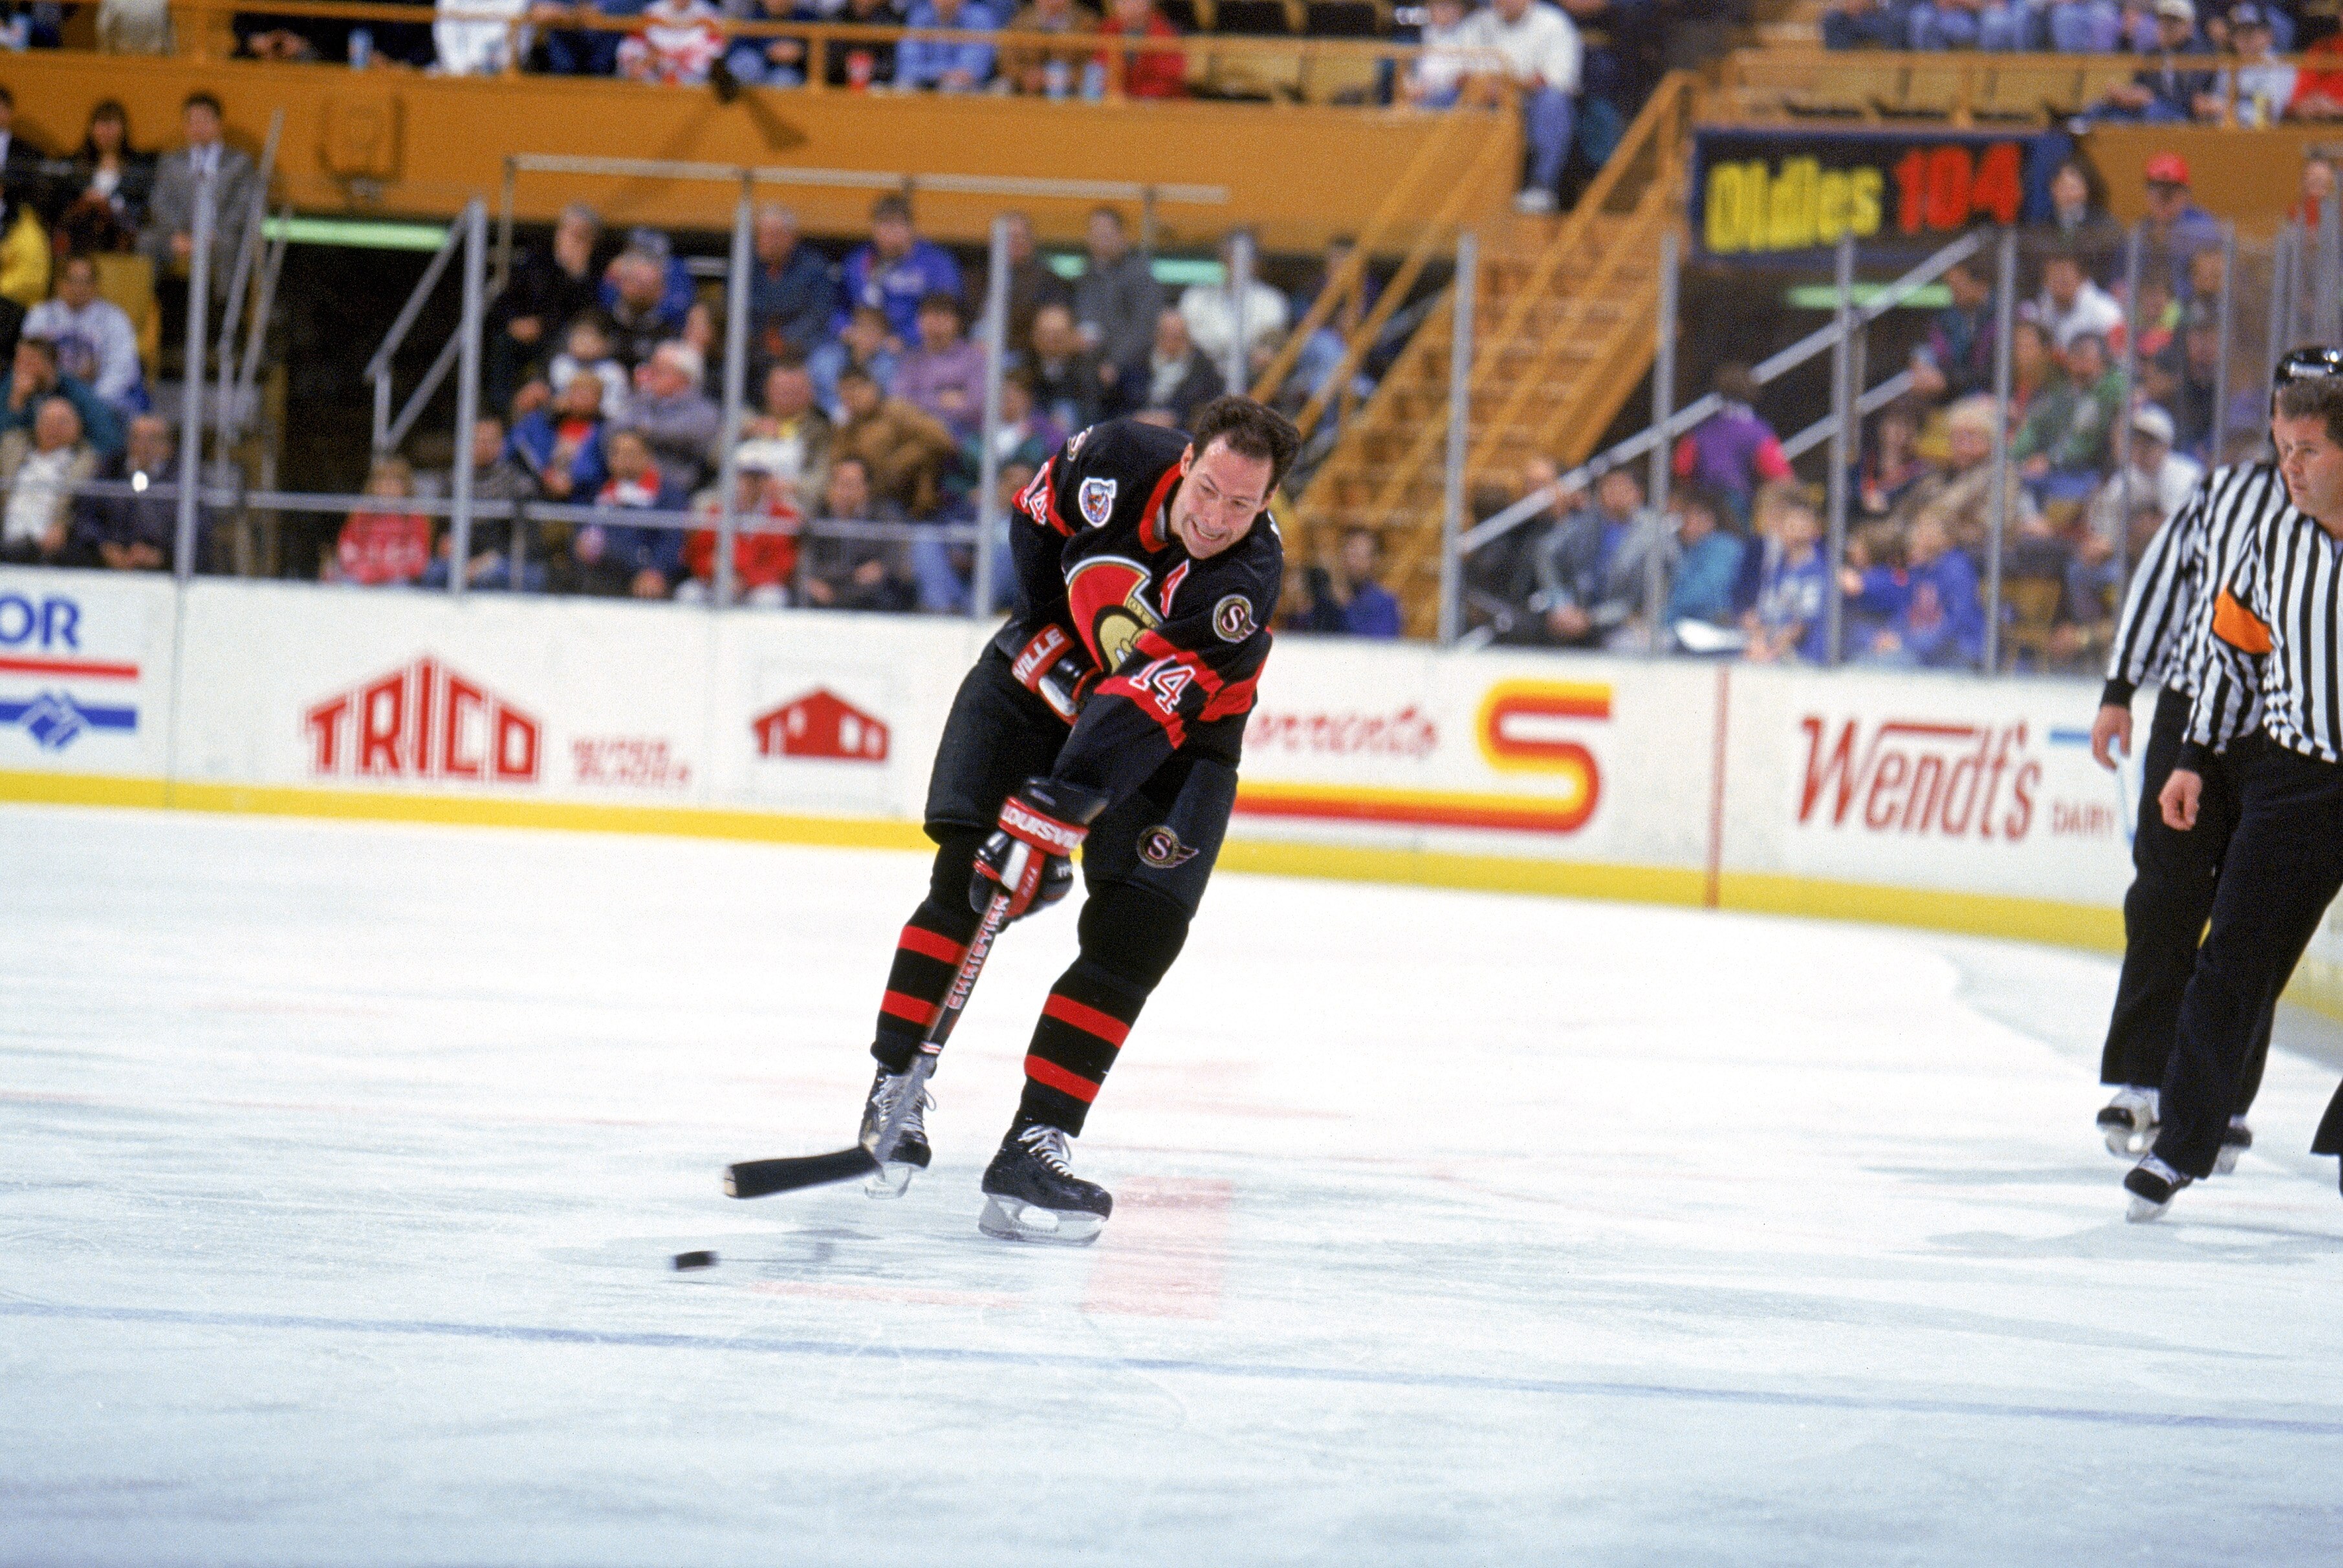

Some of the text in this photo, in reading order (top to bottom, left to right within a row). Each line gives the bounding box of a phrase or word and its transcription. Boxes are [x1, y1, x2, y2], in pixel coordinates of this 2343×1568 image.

[1893, 141, 2020, 234] 104
[304, 653, 541, 784] TRICO
[1128, 653, 1196, 715] 14
[1799, 715, 2043, 842] Wendt's
